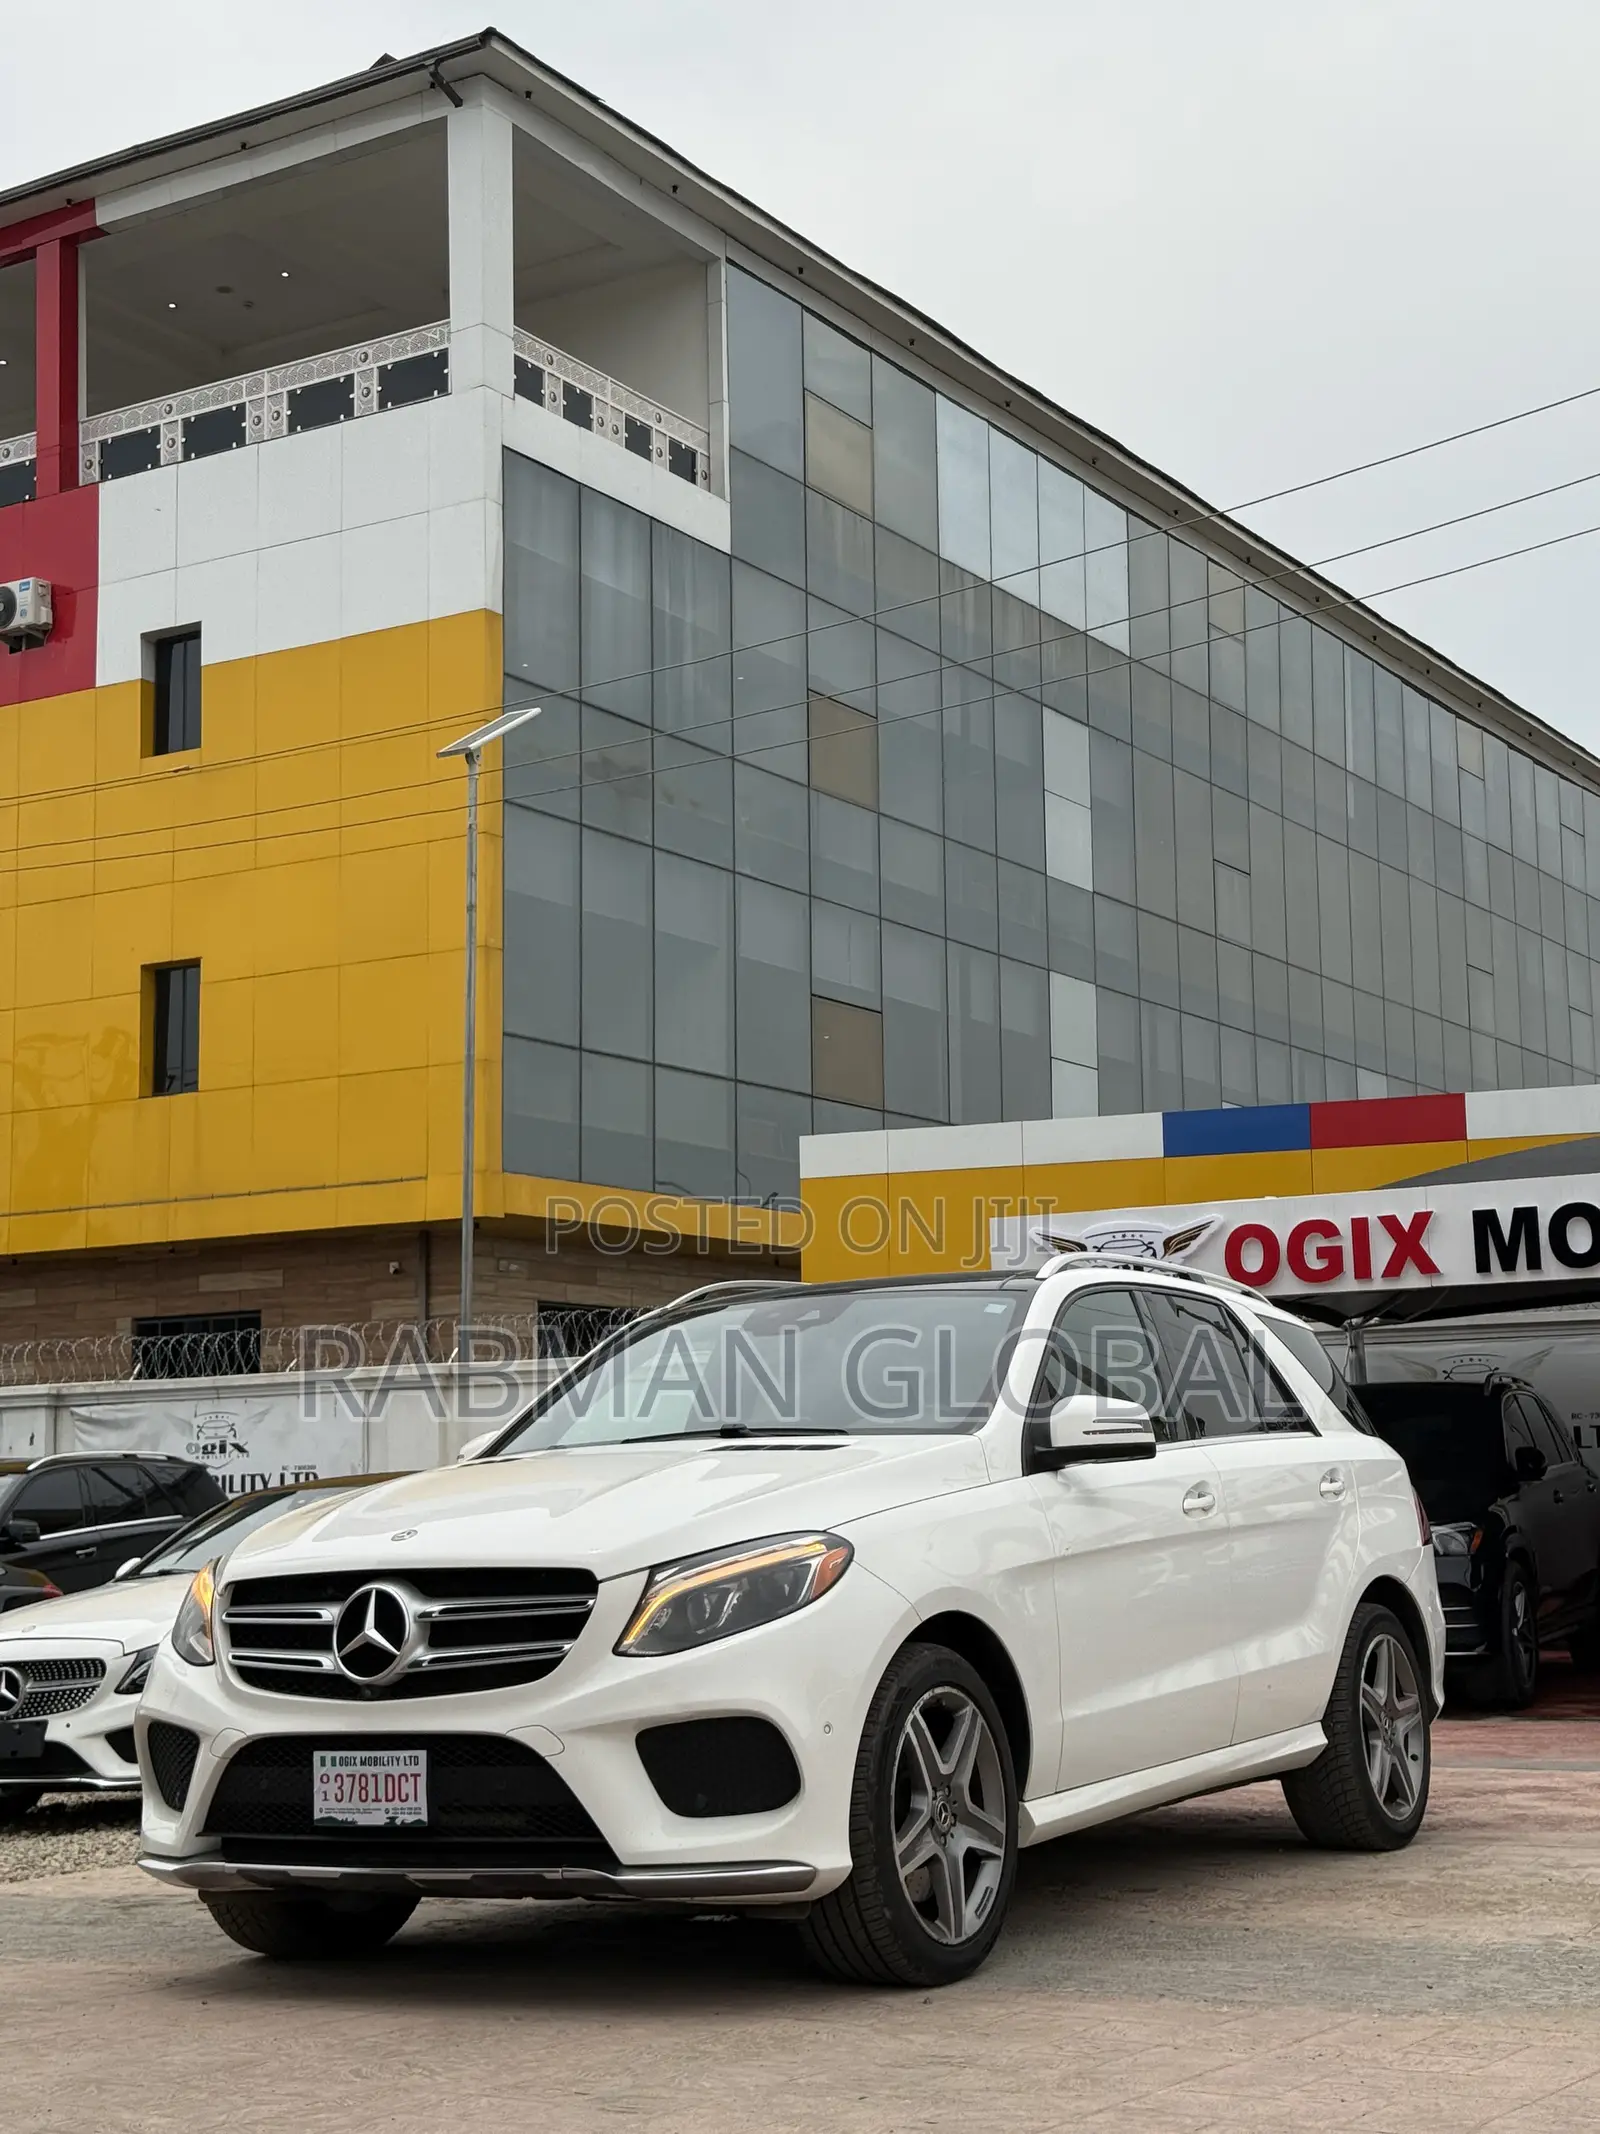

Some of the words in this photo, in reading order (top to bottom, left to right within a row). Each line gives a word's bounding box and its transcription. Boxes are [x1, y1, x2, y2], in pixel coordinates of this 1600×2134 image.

[1224, 1209, 1443, 1287] OGIX
[1471, 1201, 1600, 1275] MO
[339, 1756, 357, 1767] OGIX
[360, 1756, 401, 1767] MOBILITY
[404, 1755, 419, 1766] LTD
[334, 1773, 421, 1803] 3781DCT
